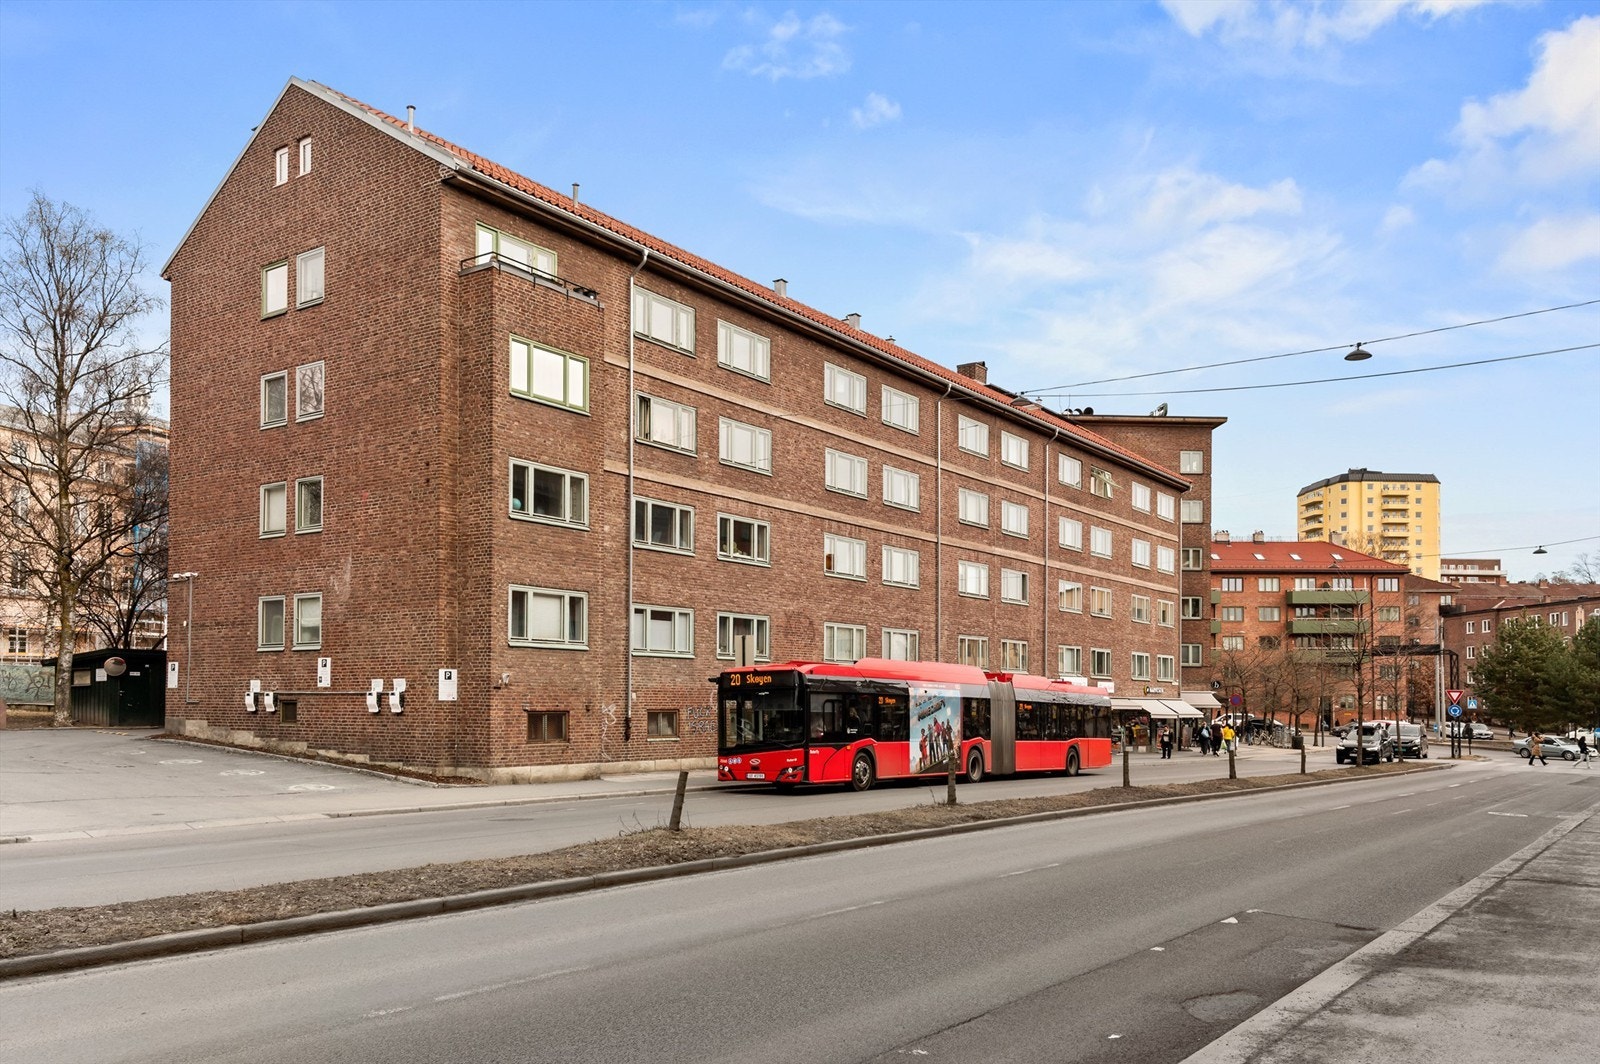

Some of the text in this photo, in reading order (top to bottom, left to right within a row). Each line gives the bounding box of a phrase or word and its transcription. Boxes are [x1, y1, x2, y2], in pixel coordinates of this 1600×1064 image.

[445, 671, 452, 680] P
[730, 673, 772, 686] 20 Skøyen
[687, 706, 711, 719] FUCK
[688, 720, 718, 734] ISRAE
